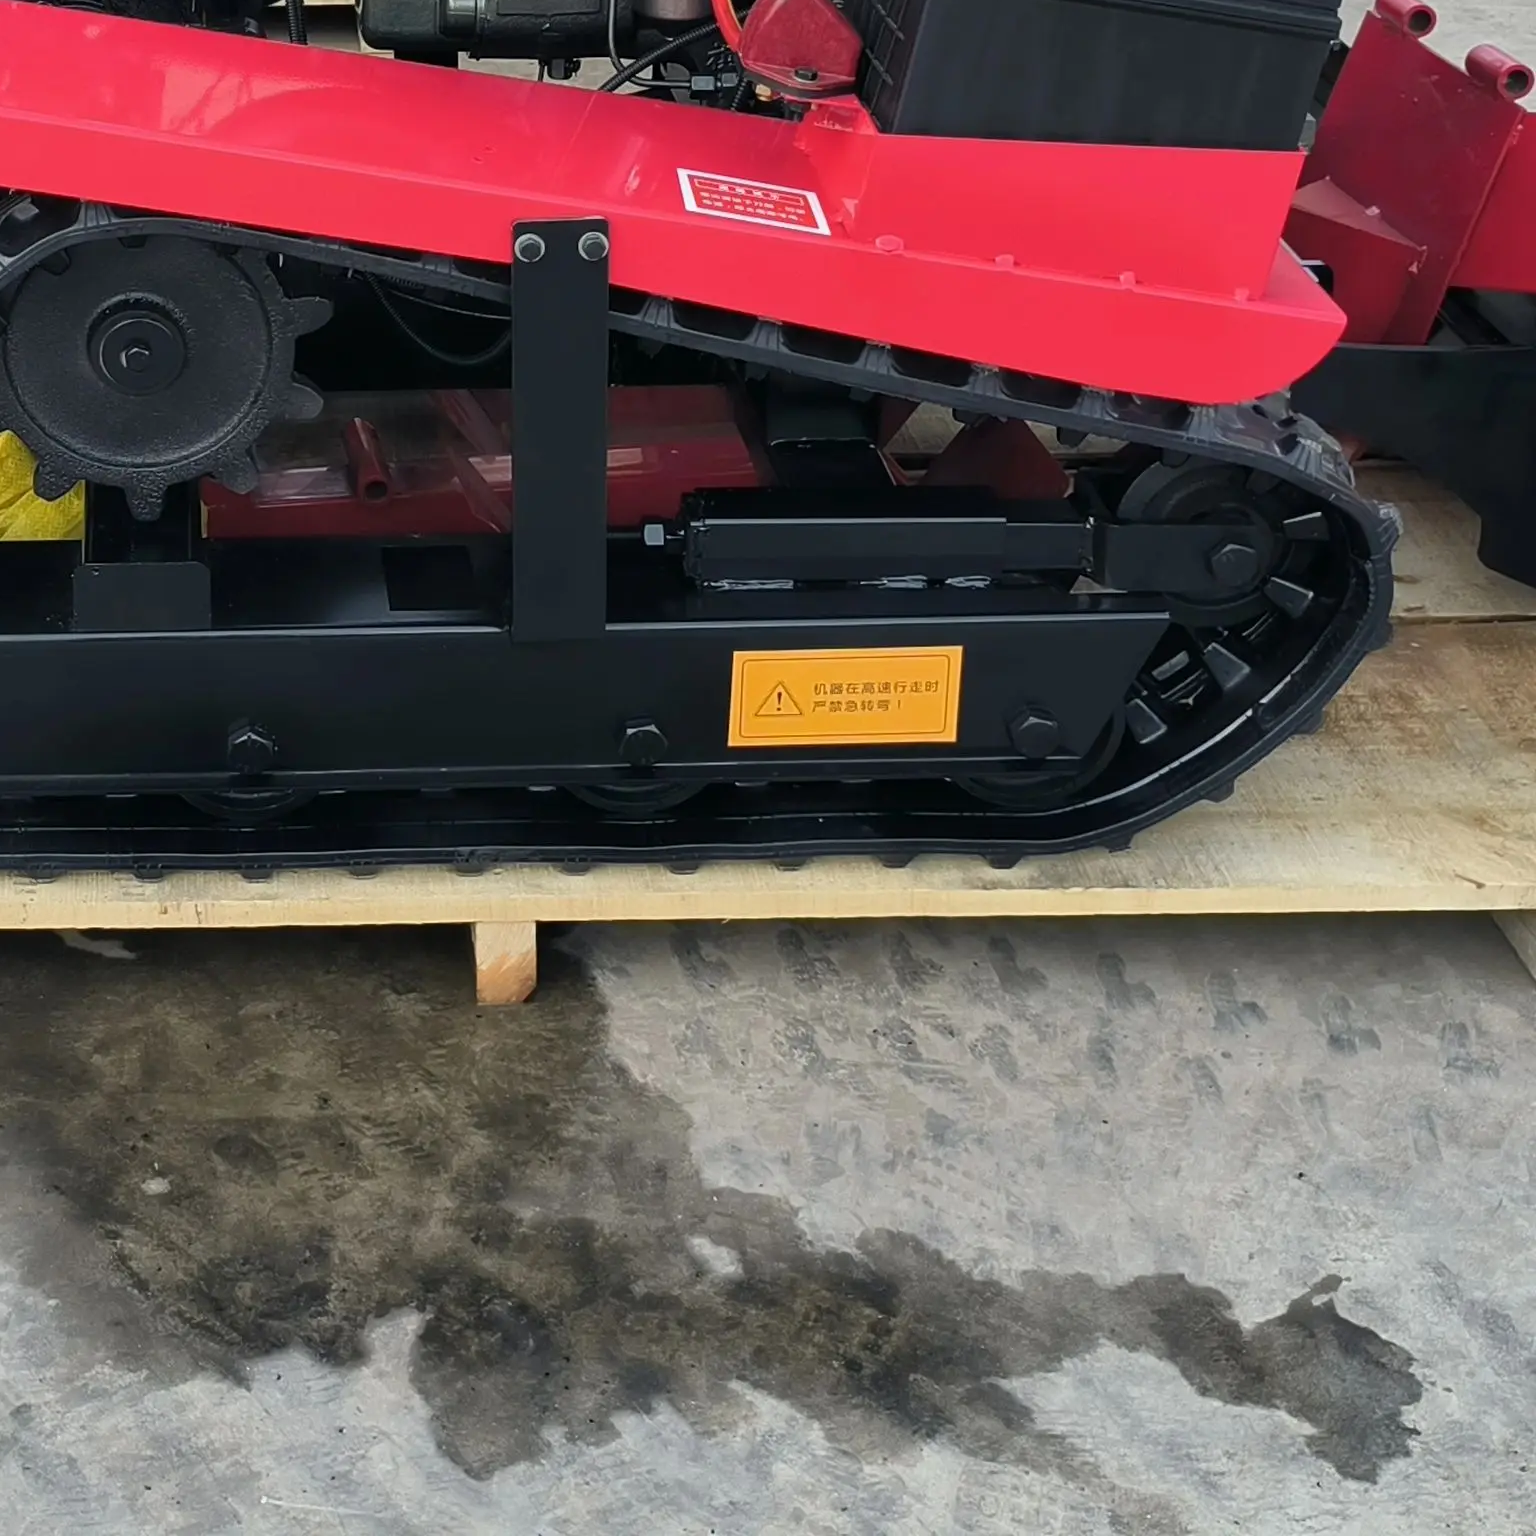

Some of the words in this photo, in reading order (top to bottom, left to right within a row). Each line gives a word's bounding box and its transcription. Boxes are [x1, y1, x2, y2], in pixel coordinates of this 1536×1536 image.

[814, 680, 940, 696] 机器在高速行走时
